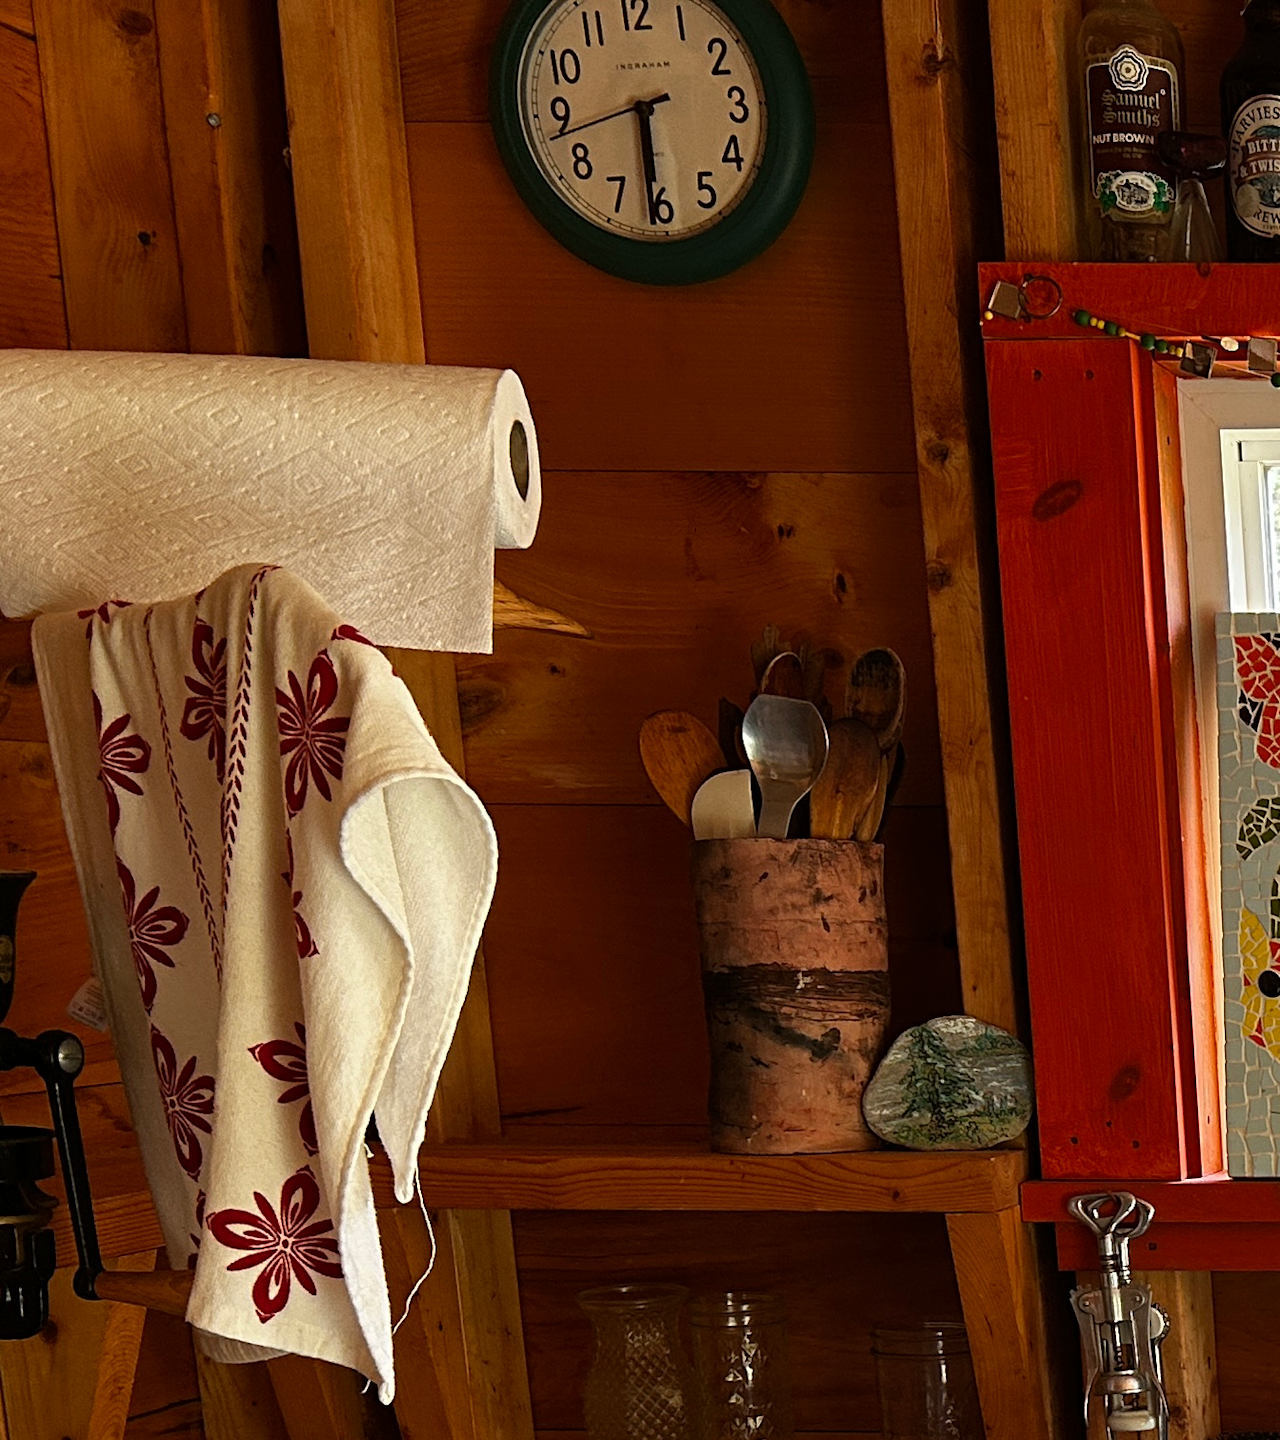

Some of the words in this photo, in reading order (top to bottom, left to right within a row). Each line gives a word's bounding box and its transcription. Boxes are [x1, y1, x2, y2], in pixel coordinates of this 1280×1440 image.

[582, 11, 604, 47] 11
[621, 0, 652, 31] 12
[676, 5, 686, 41] 1
[550, 48, 581, 85] 10
[616, 60, 671, 71] INGRAHAM
[707, 37, 731, 75] 2
[550, 96, 571, 134] 9
[727, 85, 749, 123] 3
[721, 134, 744, 172] 4
[1093, 132, 1111, 145] NUT
[1112, 132, 1154, 145] BROWN
[571, 142, 593, 180] 8
[1239, 164, 1249, 178] &
[606, 175, 626, 213] 7
[653, 187, 674, 224] 6
[697, 171, 717, 209] 5
